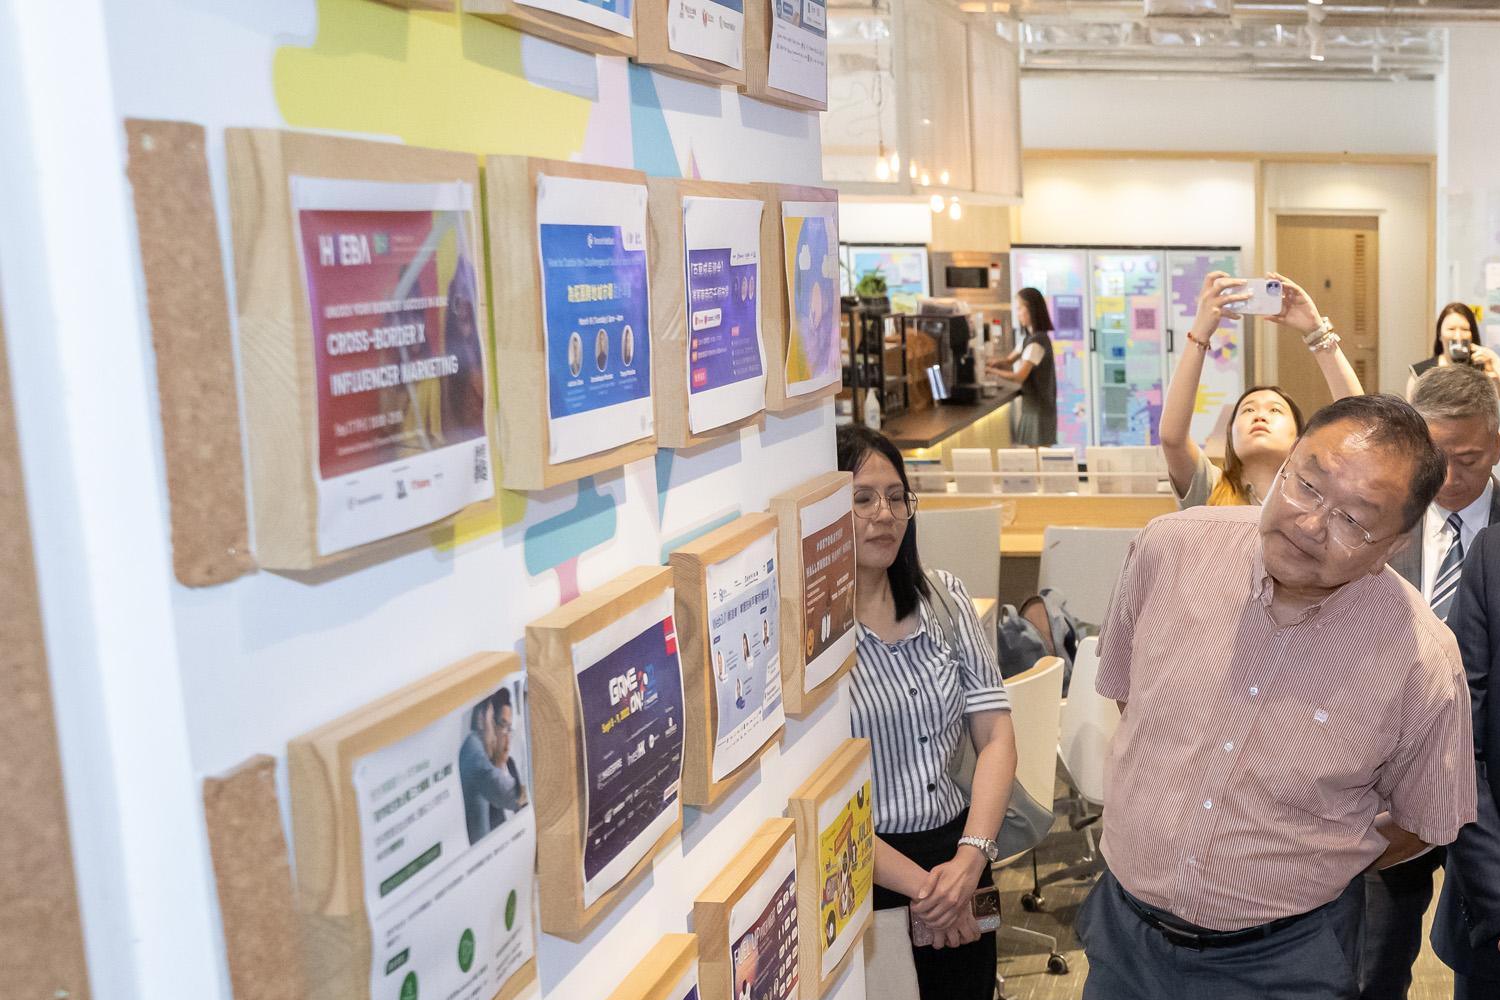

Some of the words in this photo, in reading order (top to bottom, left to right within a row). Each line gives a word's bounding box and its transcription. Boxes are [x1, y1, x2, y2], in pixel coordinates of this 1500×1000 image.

[327, 324, 417, 356] CROSS-BORDER
[329, 365, 400, 396] INFLUENCER
[400, 355, 459, 384] MARKETING
